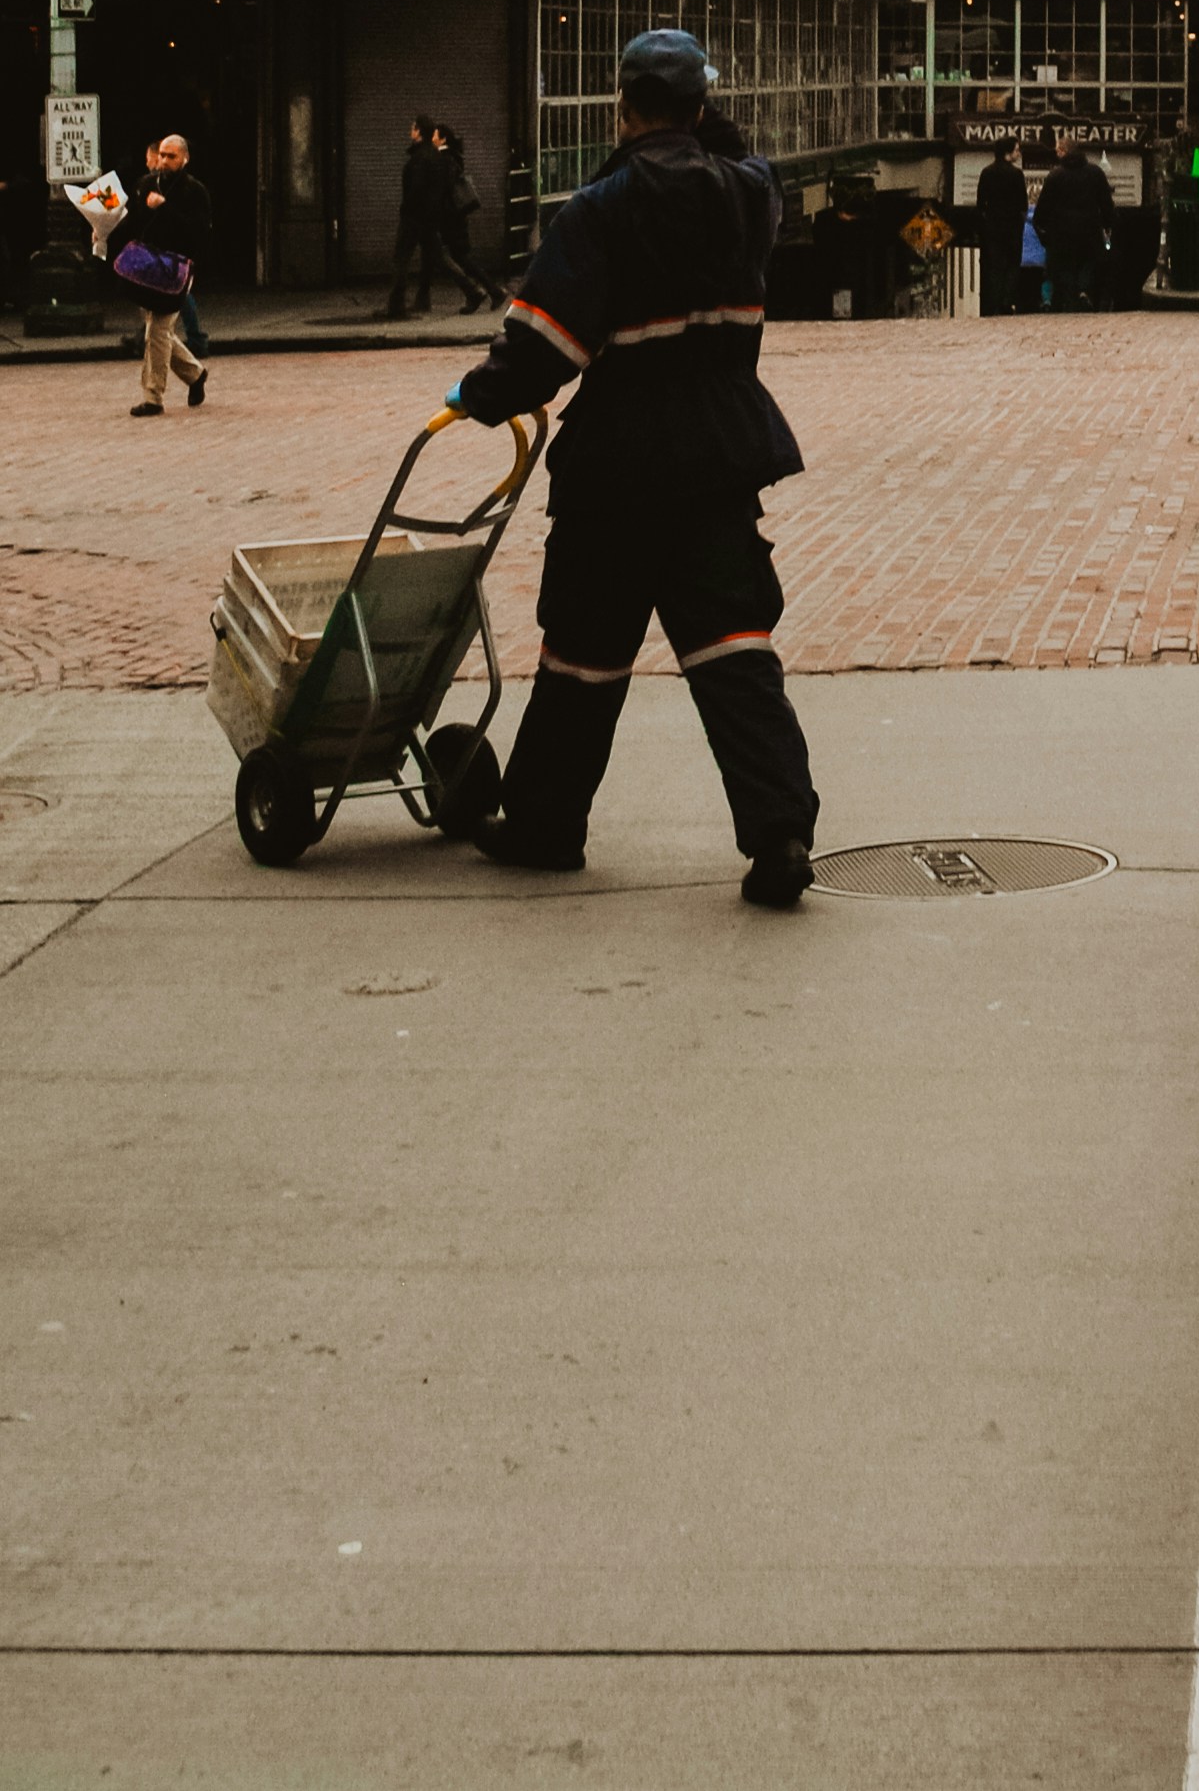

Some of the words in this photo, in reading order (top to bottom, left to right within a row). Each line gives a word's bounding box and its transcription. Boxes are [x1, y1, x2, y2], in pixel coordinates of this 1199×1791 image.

[54, 102, 70, 112] ALL
[74, 101, 93, 111] WAY
[61, 116, 85, 126] WALK
[965, 124, 1043, 142] MARKET
[1052, 125, 1138, 142] THEATER
